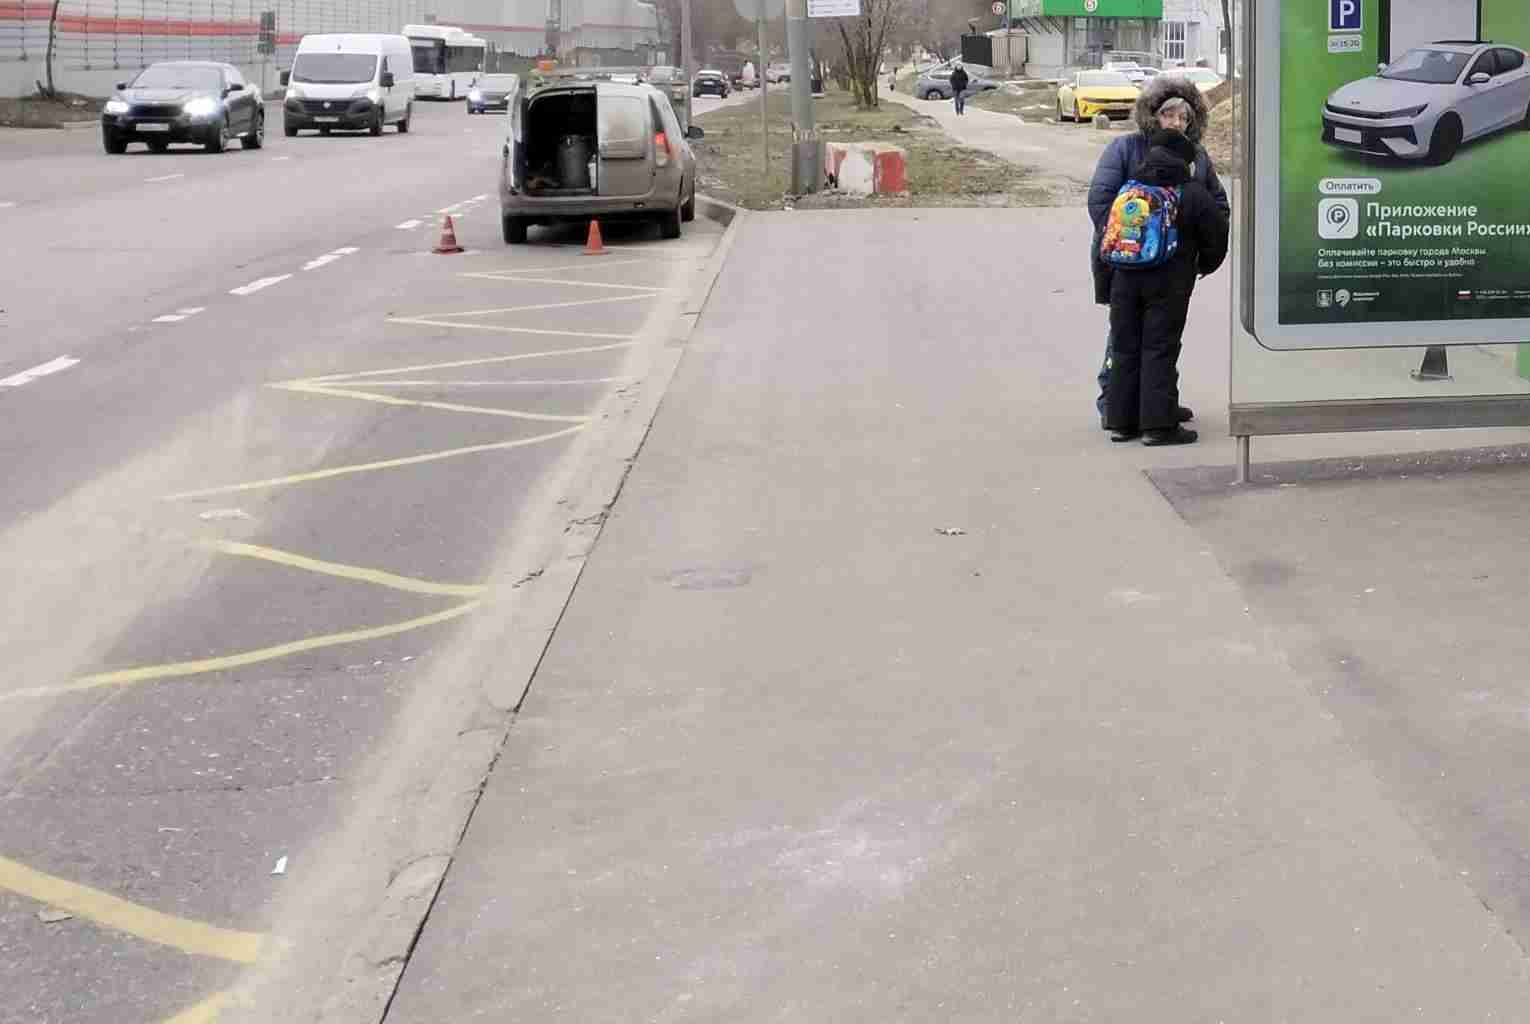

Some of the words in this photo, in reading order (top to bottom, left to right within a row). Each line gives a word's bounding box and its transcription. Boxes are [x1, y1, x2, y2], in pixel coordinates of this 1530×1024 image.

[1339, 0, 1355, 26] P
[1326, 181, 1375, 191] Оплатить
[1366, 202, 1478, 220] Приложение
[1366, 221, 1462, 240] «Парковки
[1318, 248, 1376, 257] Оплачивайте
[1377, 248, 1418, 258] парковку
[1419, 248, 1450, 257] города
[1403, 257, 1436, 268] быстро
